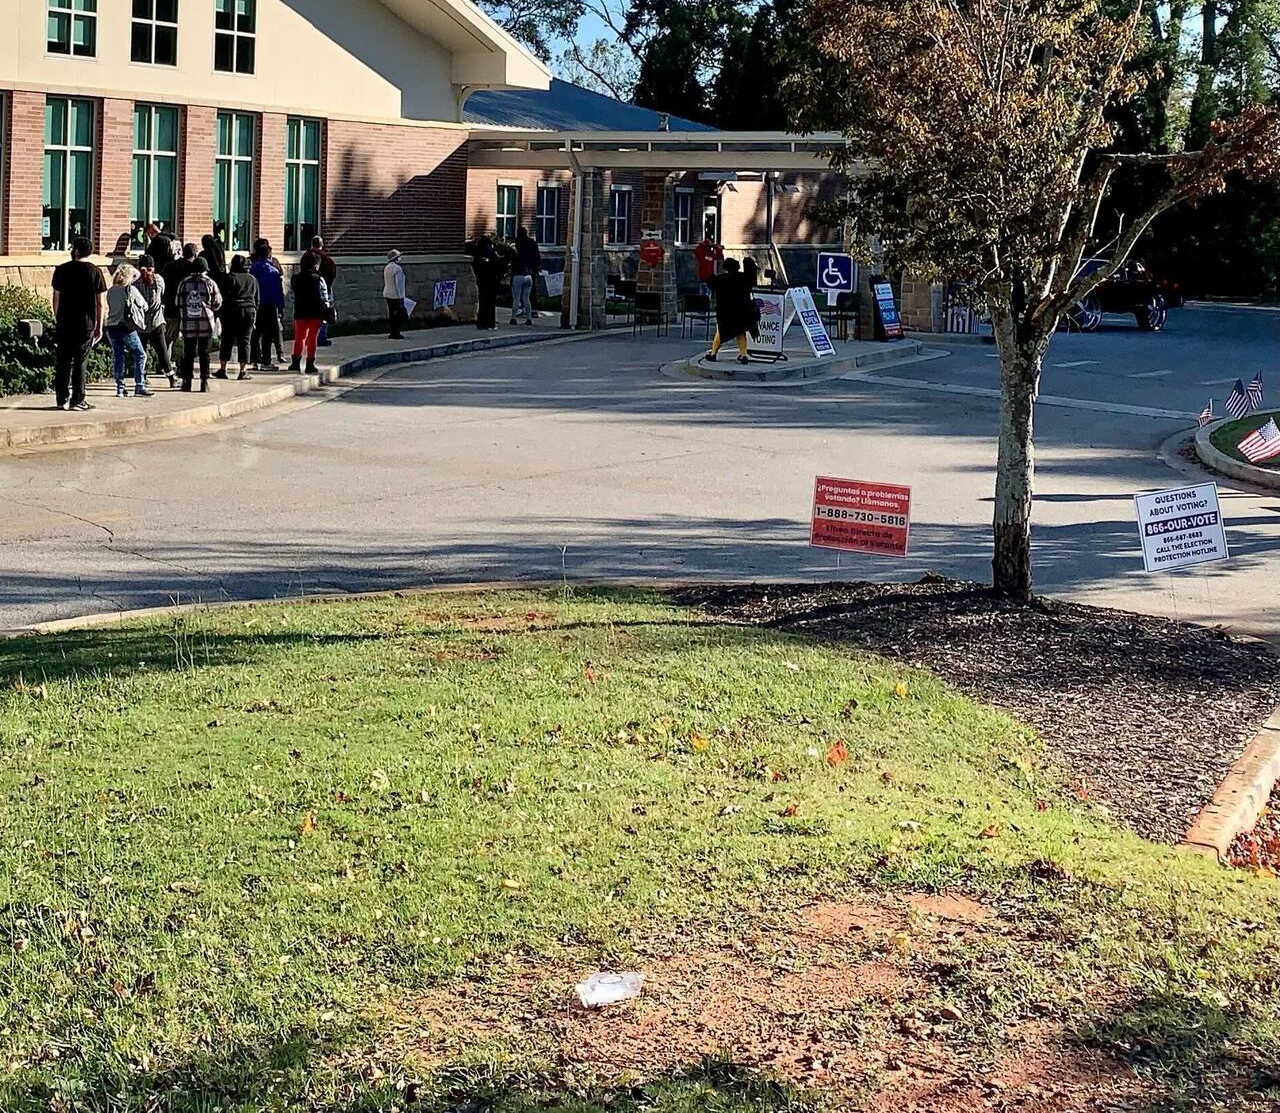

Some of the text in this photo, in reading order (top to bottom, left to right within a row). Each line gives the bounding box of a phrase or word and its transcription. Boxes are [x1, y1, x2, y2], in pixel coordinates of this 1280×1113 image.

[758, 321, 780, 332] VANCE
[804, 316, 820, 325] OPEN
[824, 493, 860, 504] votando?
[867, 490, 909, 501] problemas
[1154, 490, 1197, 504] QUESTIONS
[1149, 499, 1208, 517] ABOUT VOTING?
[816, 506, 906, 526] 1-888-730-5816
[1146, 513, 1217, 534] 866-OUR-VOTE
[1156, 538, 1213, 554] CALL THE ELECTION
[1154, 546, 1218, 563] PROTECTION HOTLINE
